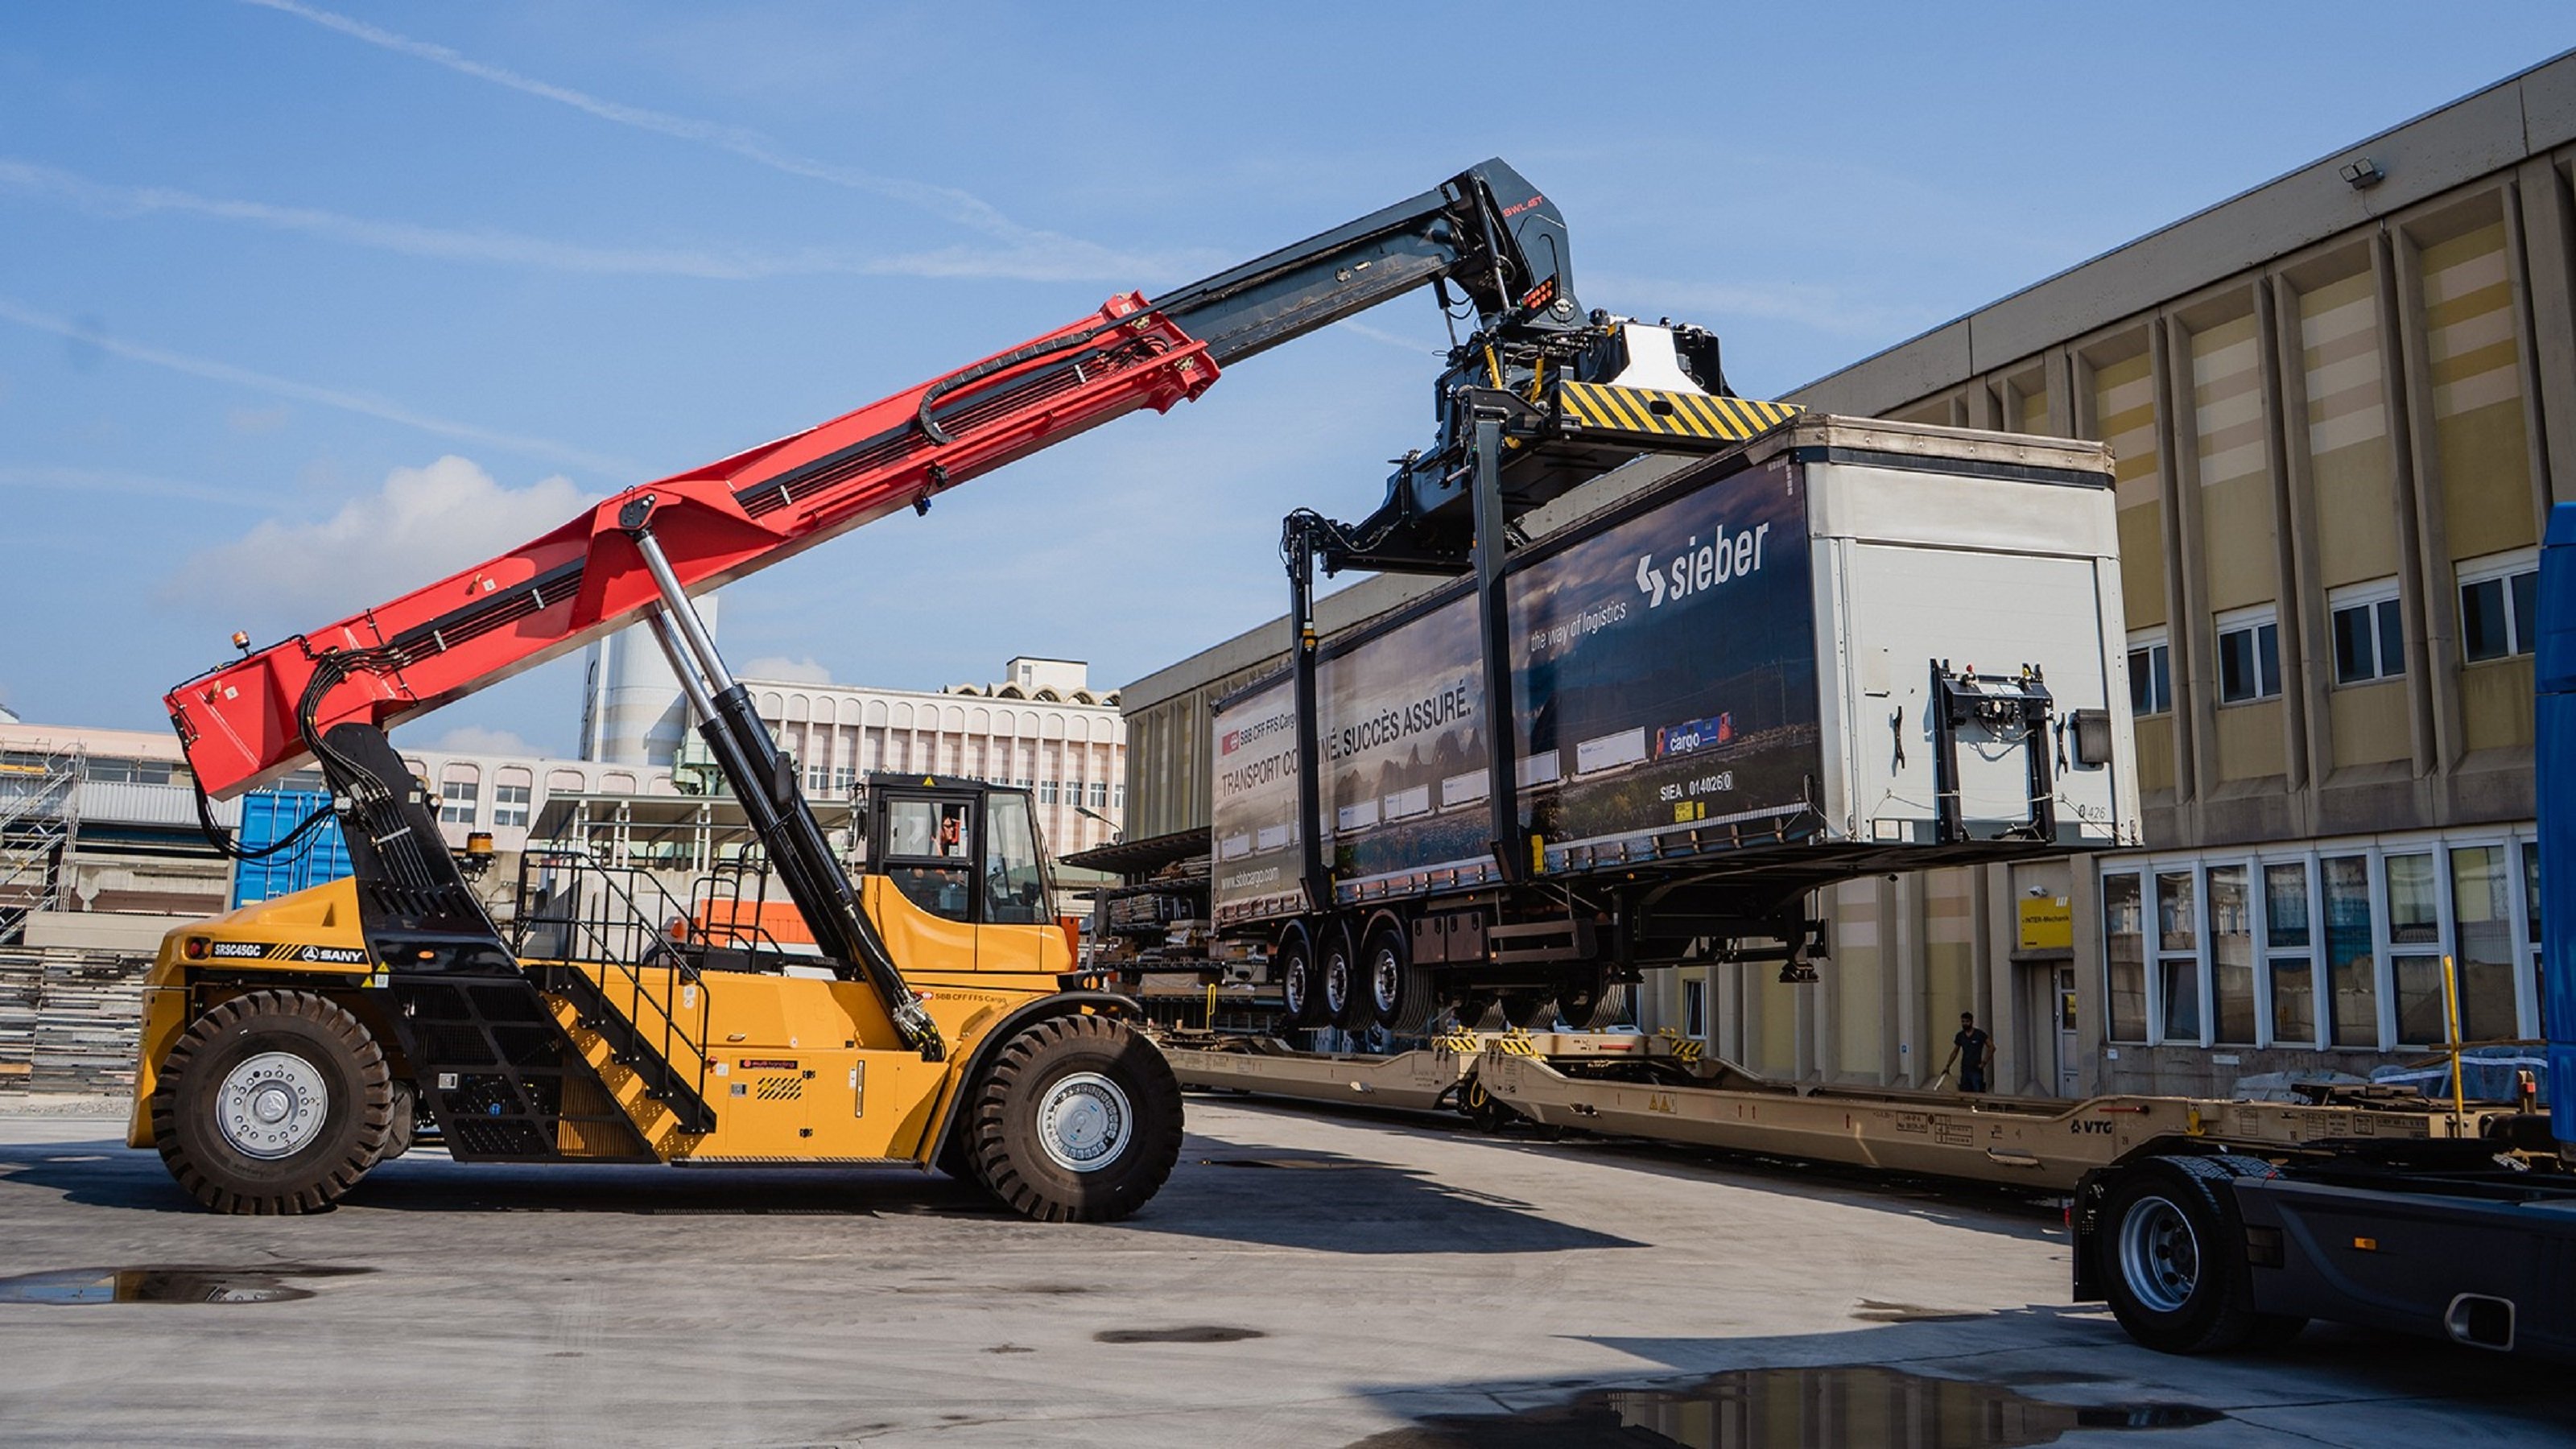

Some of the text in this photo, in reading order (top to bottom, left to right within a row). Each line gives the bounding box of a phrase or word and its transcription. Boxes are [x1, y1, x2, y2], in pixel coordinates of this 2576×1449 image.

[1670, 522, 1769, 601] sieber
[1530, 600, 1627, 652] the way of logistics
[1222, 754, 1281, 797] TRANSPORT
[1344, 708, 1400, 757] SUCCÈS
[1402, 679, 1472, 737] ASSURÉ.
[1240, 727, 1253, 745] SBB
[1265, 716, 1279, 737] FFS
[1280, 712, 1296, 731] Carg
[1670, 732, 1700, 753] cargo
[1660, 783, 1683, 801] SIEA
[320, 949, 363, 962] SANY
[935, 993, 952, 1001] SBB
[2083, 1121, 2112, 1134] VTG
